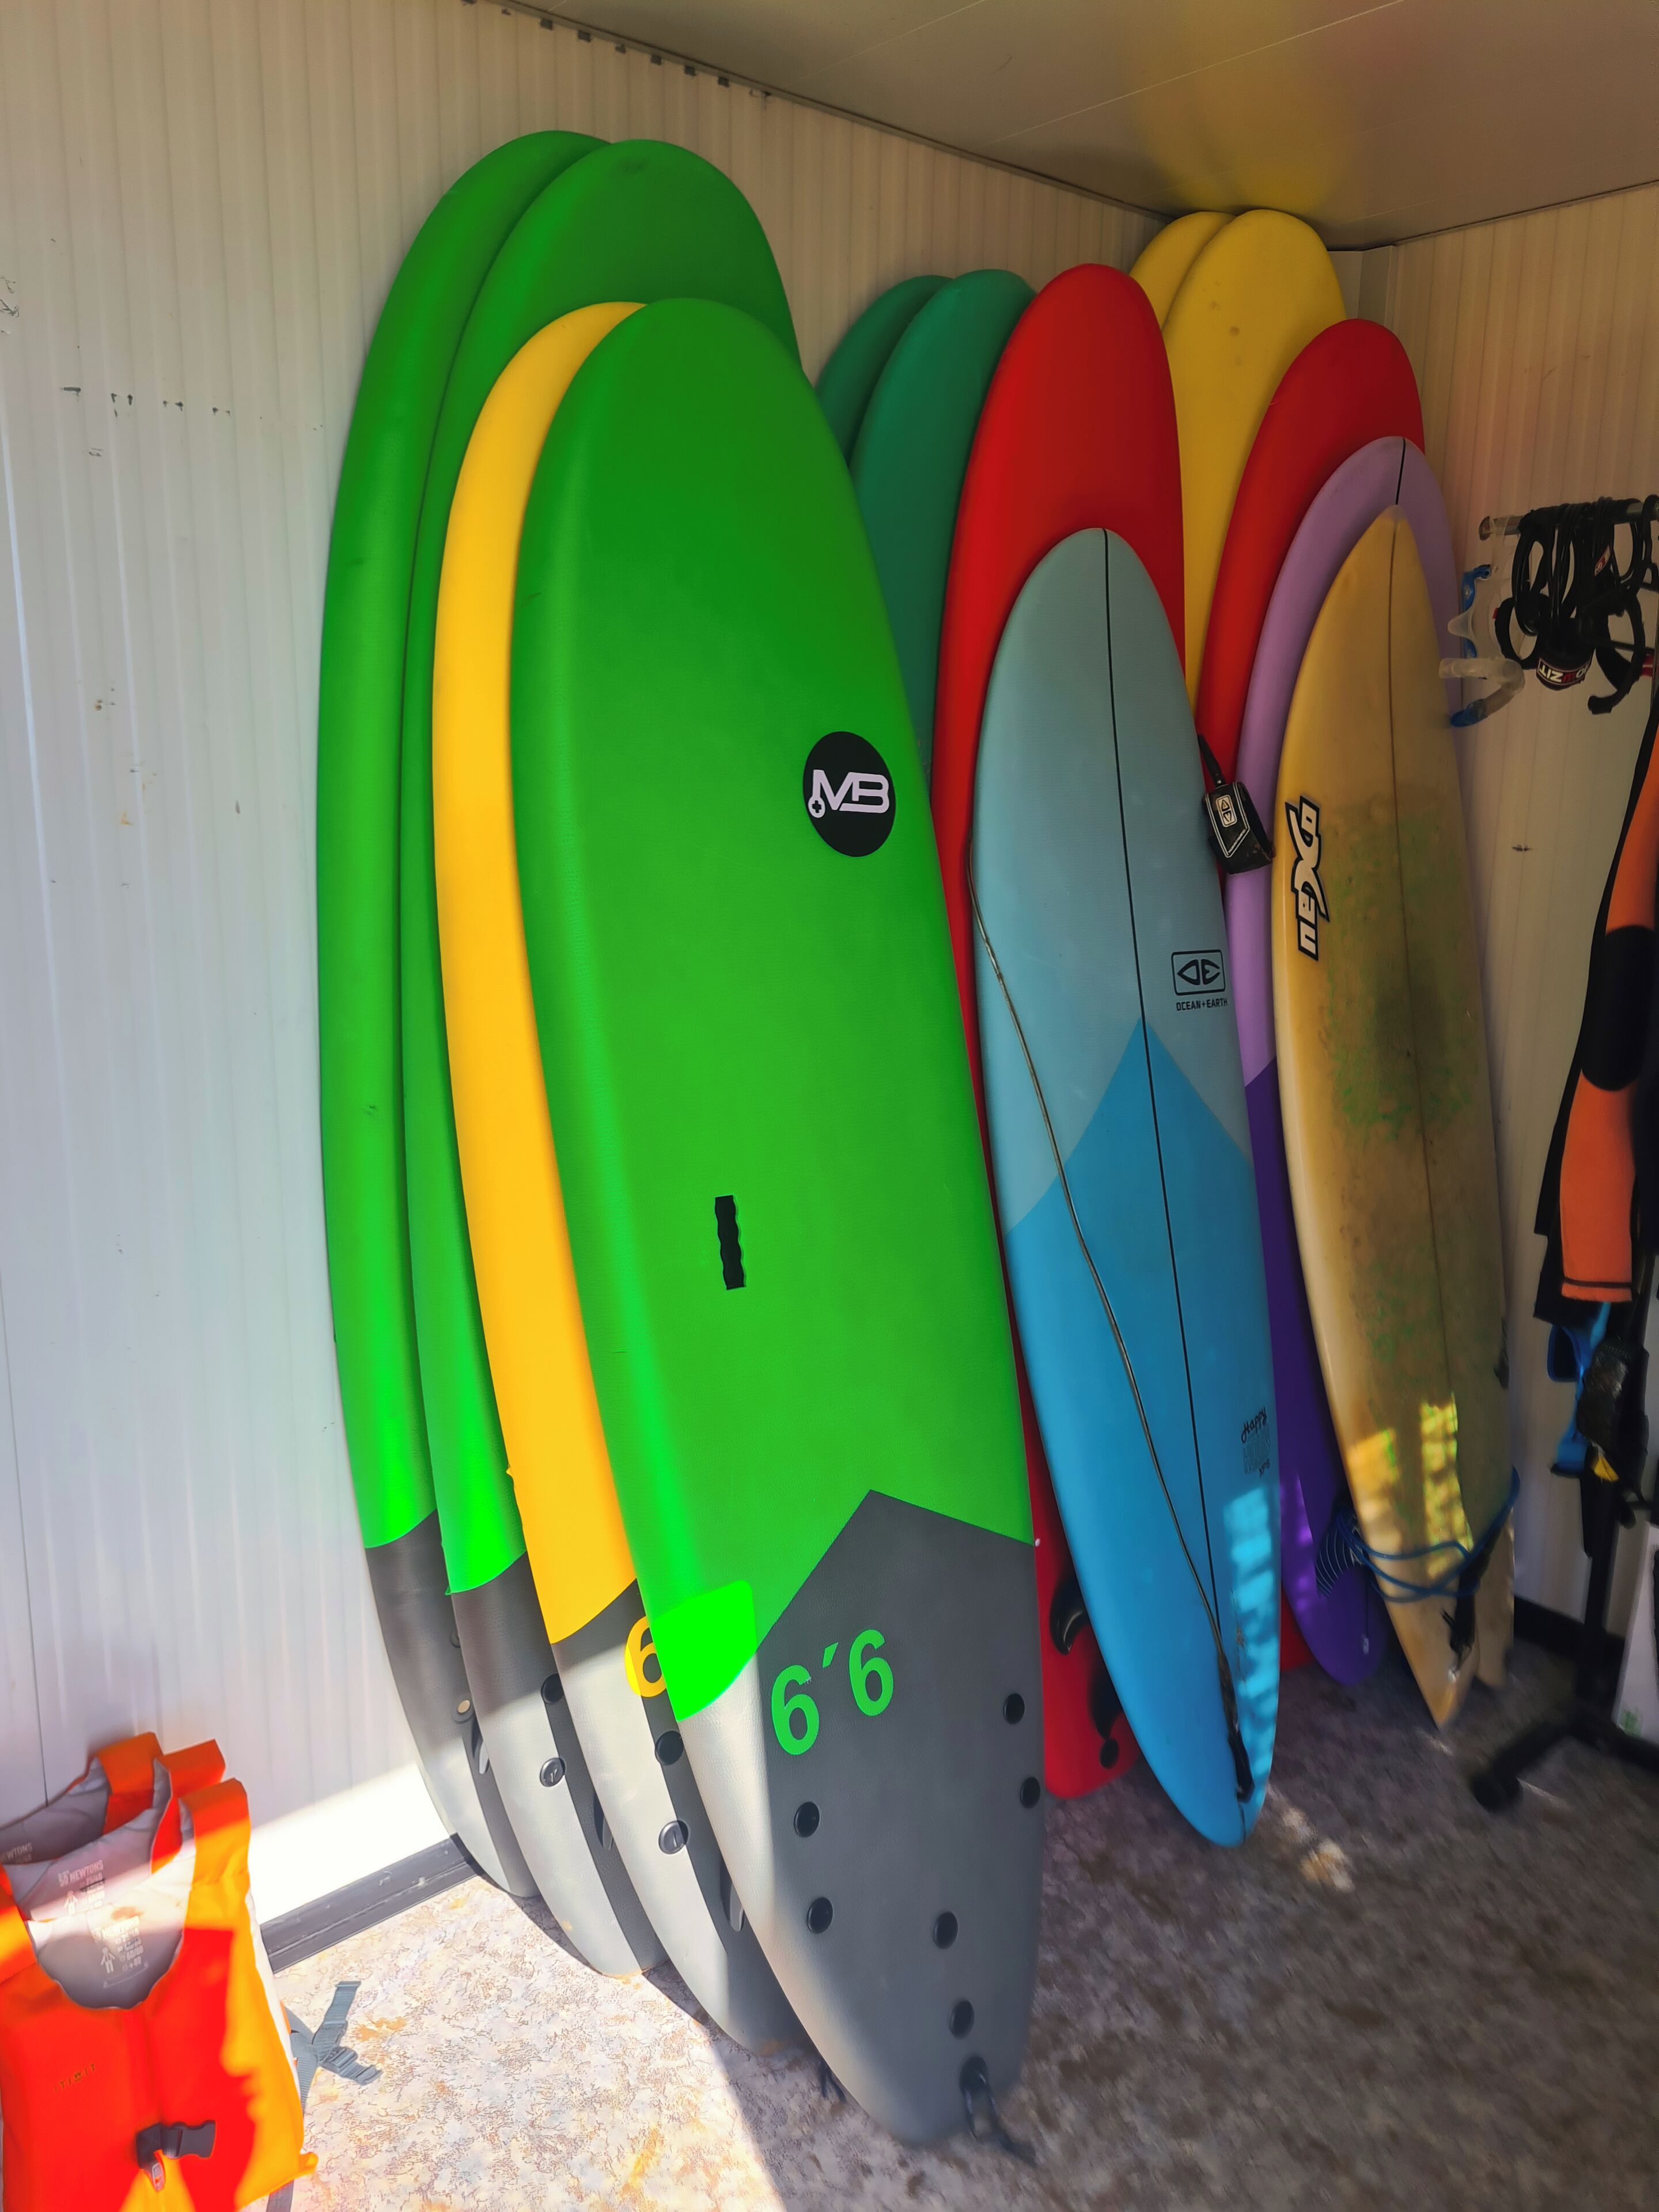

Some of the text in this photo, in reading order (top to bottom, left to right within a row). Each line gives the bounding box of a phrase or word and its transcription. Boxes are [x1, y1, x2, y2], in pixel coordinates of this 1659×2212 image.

[1176, 997, 1228, 1012] OCEAN+EARTH
[1241, 1406, 1267, 1444] Happy
[69, 1859, 104, 1883] NEWTONS
